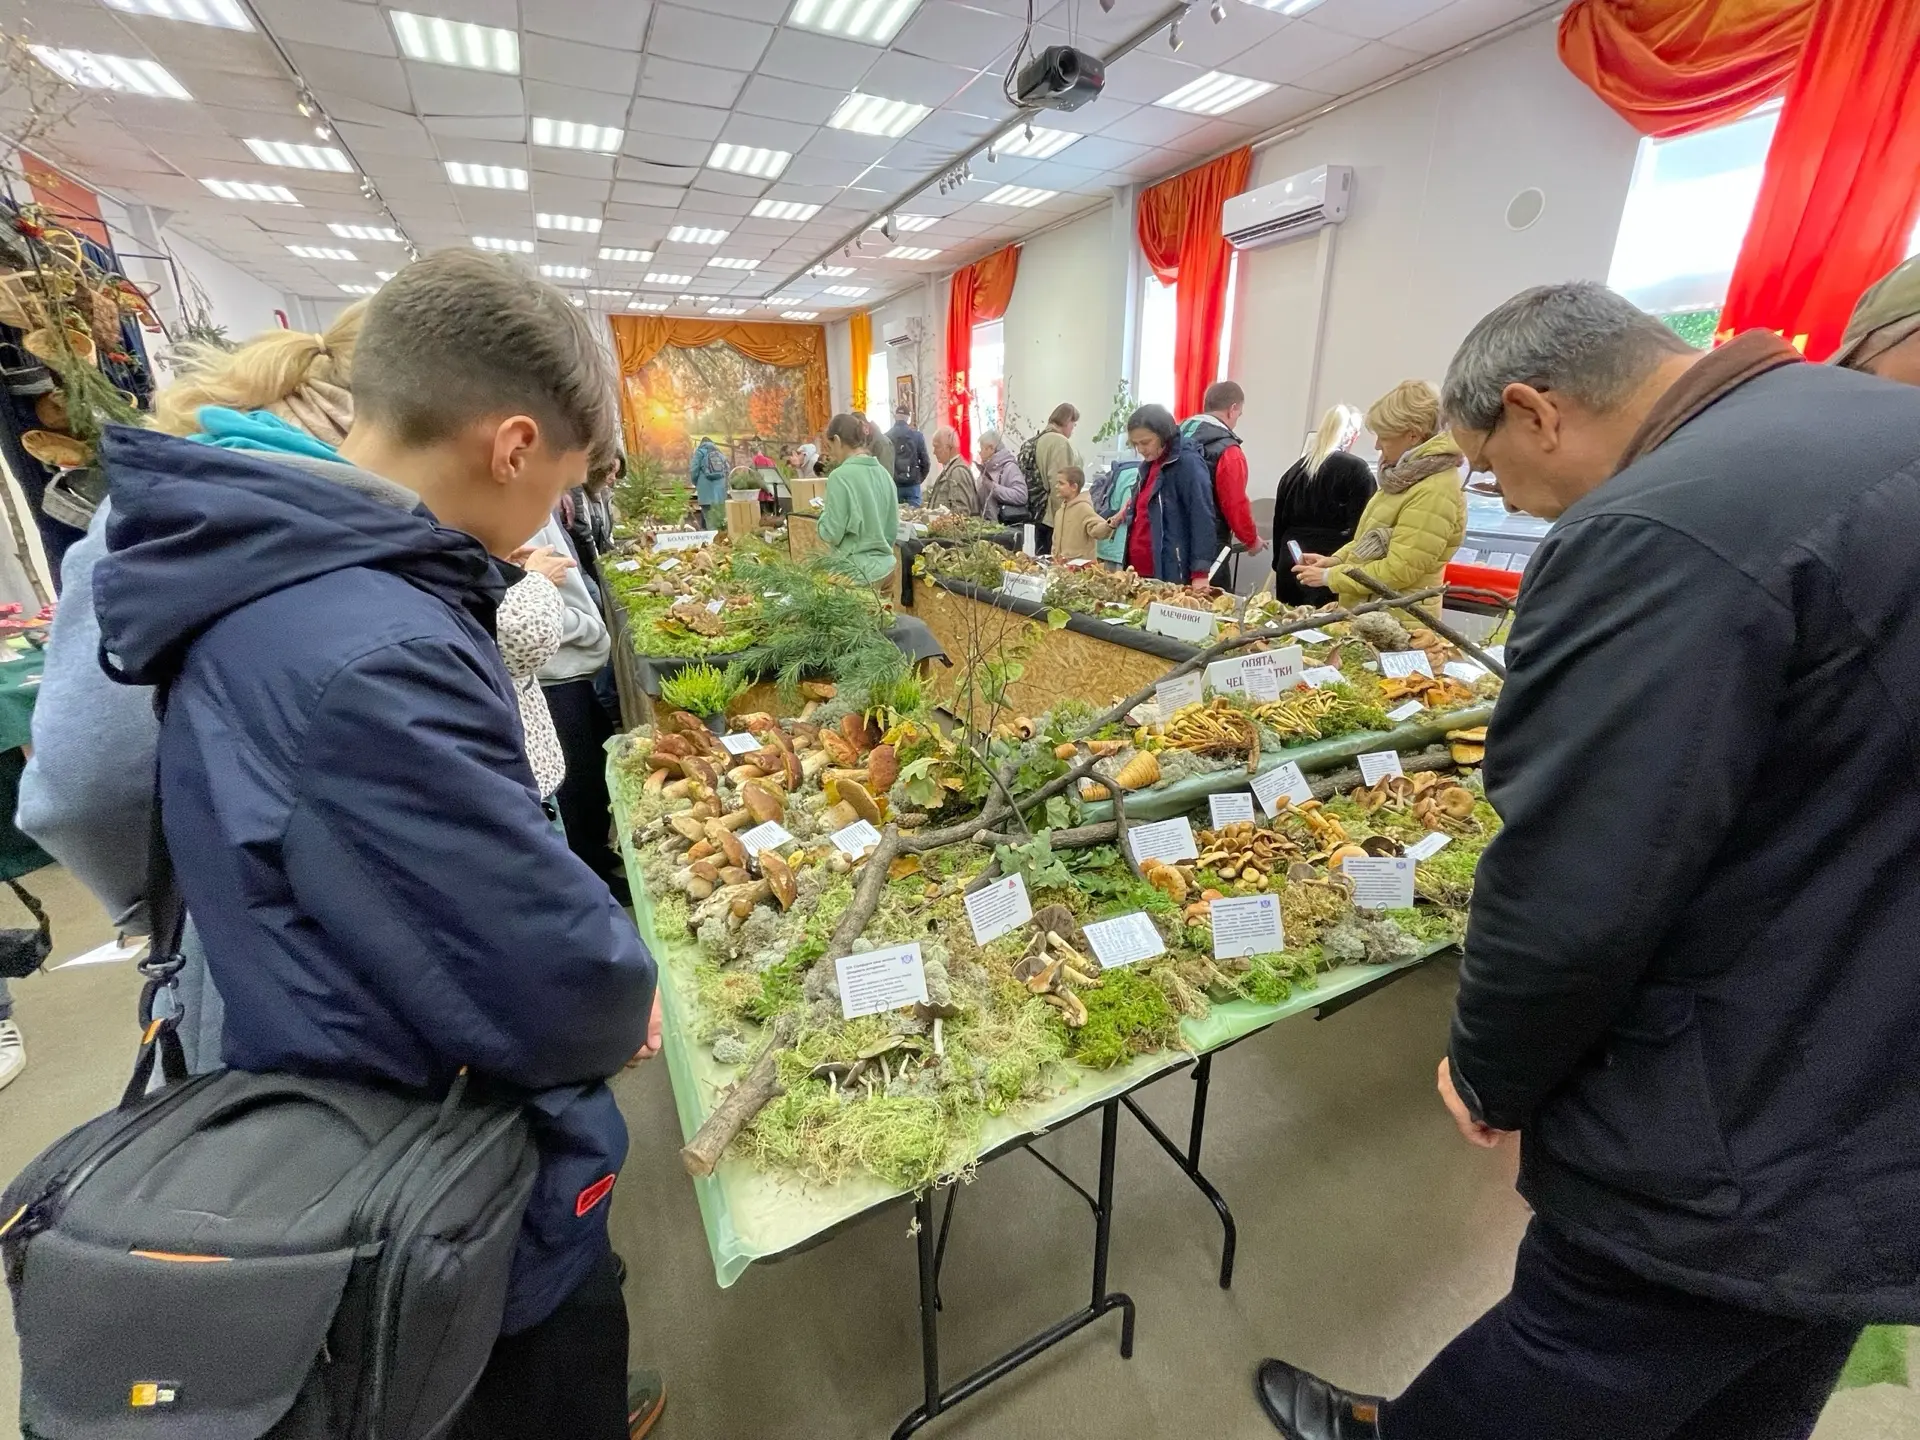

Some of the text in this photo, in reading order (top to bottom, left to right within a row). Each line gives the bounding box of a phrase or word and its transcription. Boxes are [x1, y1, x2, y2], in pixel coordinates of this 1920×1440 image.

[1160, 608, 1201, 624] МЛЕЧНИКИ
[1241, 655, 1277, 668] ОПЯТА,
[1226, 665, 1293, 688] ЧЕТКИ
